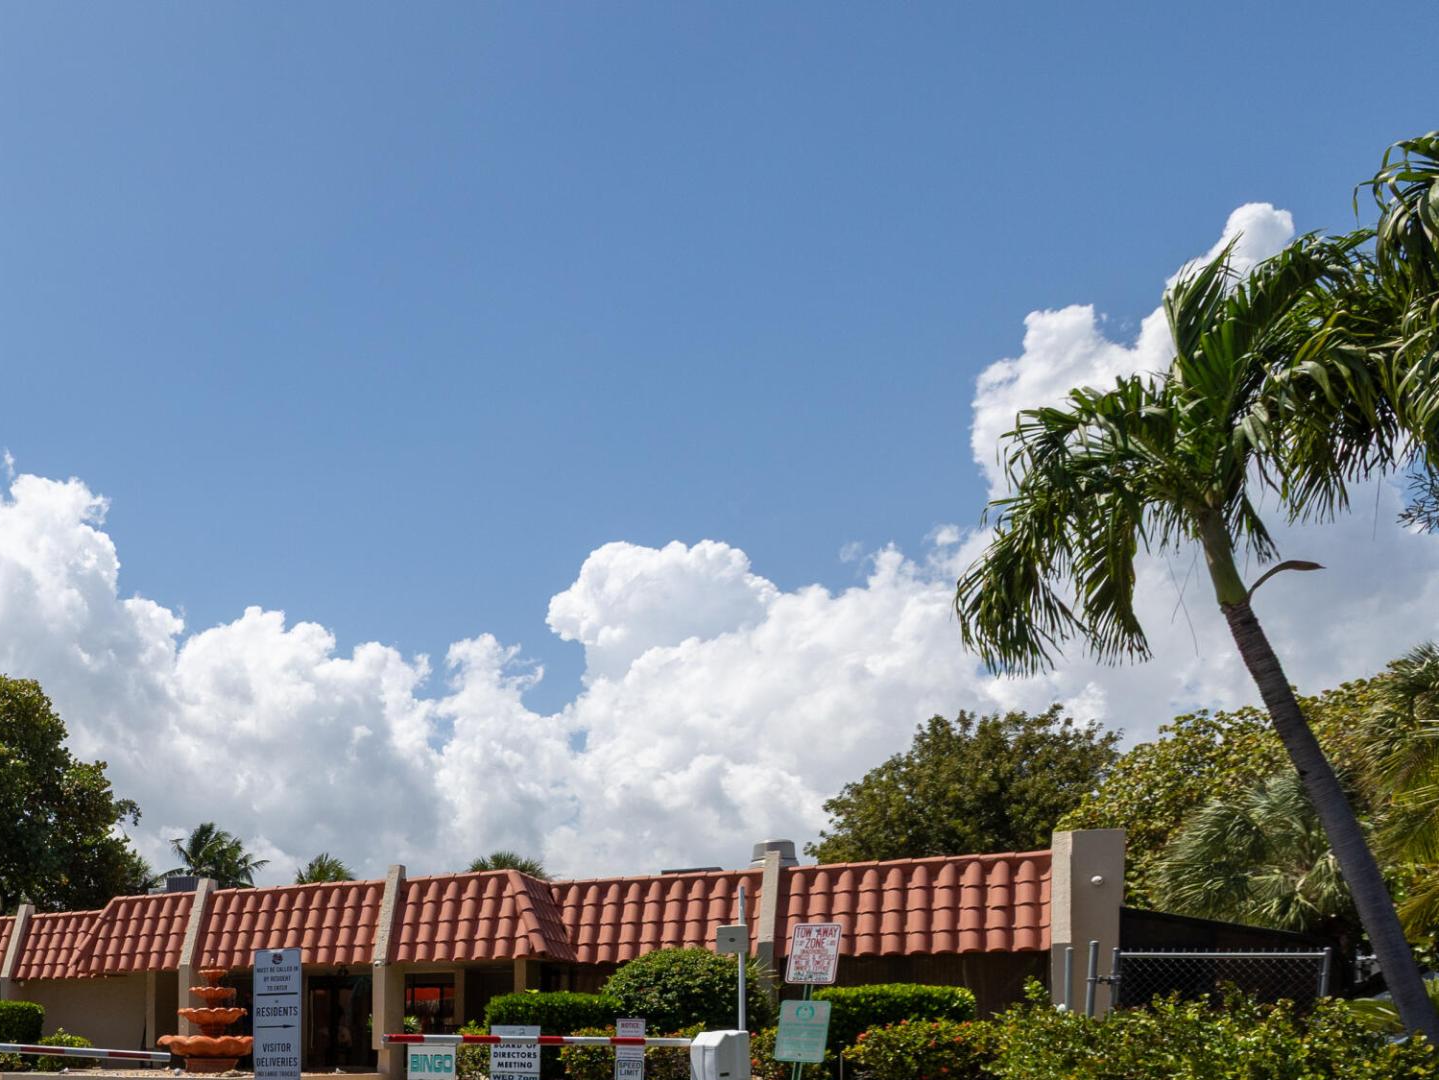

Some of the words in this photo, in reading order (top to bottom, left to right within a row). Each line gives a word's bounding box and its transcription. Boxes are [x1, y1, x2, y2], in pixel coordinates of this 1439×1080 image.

[796, 927, 813, 938] TOW
[815, 927, 839, 938] AWAY
[805, 937, 828, 949] ZONE
[256, 1006, 298, 1017] RESIDENTS
[262, 1043, 292, 1053] VISITOR
[493, 1051, 537, 1059] DIRECTORS
[256, 1057, 298, 1067] DELIVERIES
[410, 1053, 453, 1073] BINGO
[497, 1061, 533, 1069] MEETING
